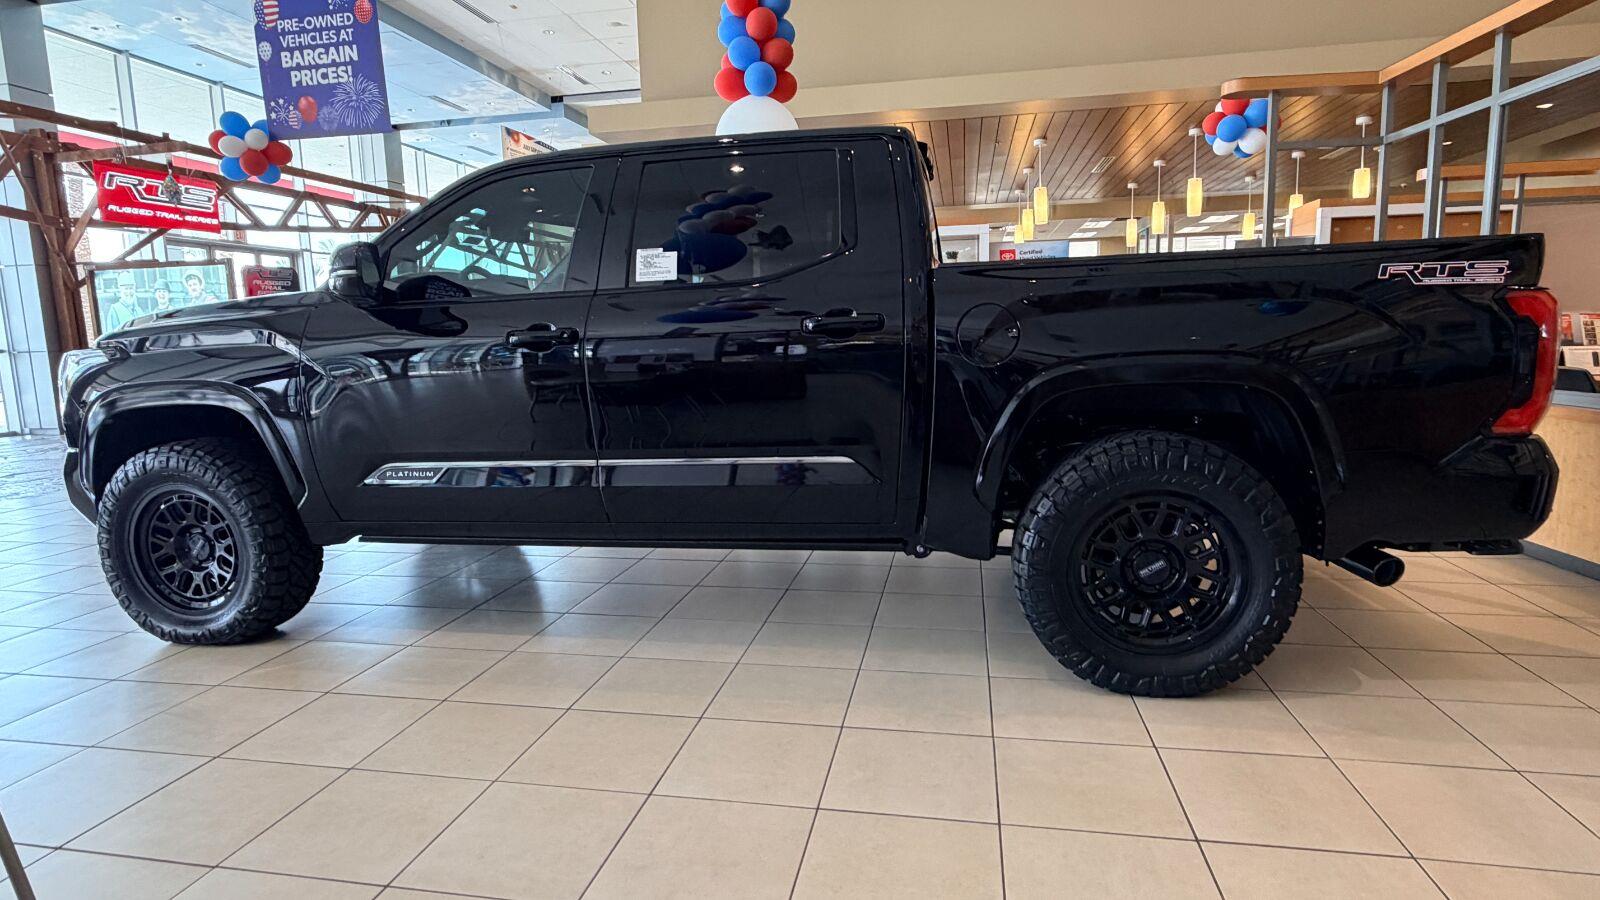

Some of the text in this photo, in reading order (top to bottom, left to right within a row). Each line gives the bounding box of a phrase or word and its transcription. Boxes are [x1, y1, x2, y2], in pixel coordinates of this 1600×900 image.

[277, 12, 354, 32] PRE-OWNED
[280, 28, 354, 48] VEHICLES AT
[281, 44, 359, 68] BARGAIN
[290, 65, 354, 87] PRICES!
[104, 171, 218, 212] RTS
[107, 204, 219, 224] RUGGED TRAIL SERIES
[1378, 260, 1509, 285] RTS
